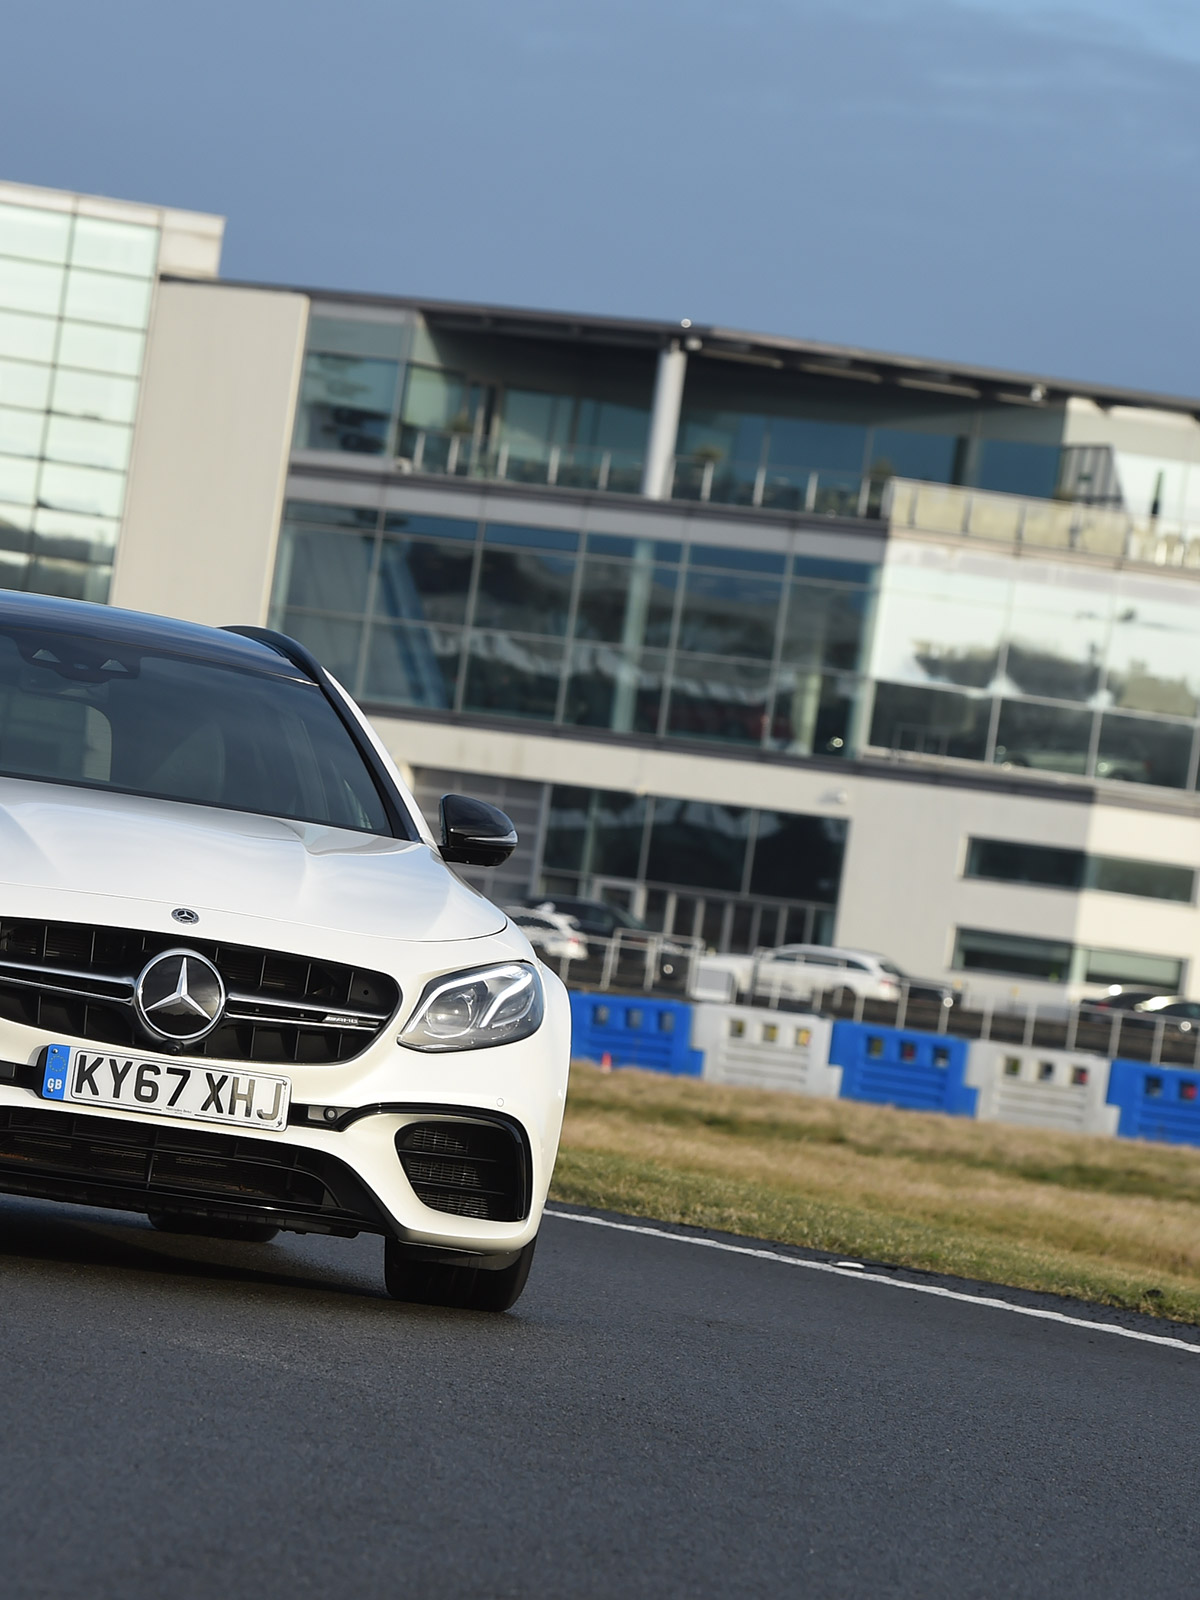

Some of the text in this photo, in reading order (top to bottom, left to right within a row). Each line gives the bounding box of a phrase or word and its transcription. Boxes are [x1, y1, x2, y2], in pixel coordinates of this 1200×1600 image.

[47, 1078, 62, 1090] GB
[75, 1055, 282, 1120] KY67 XHJ
